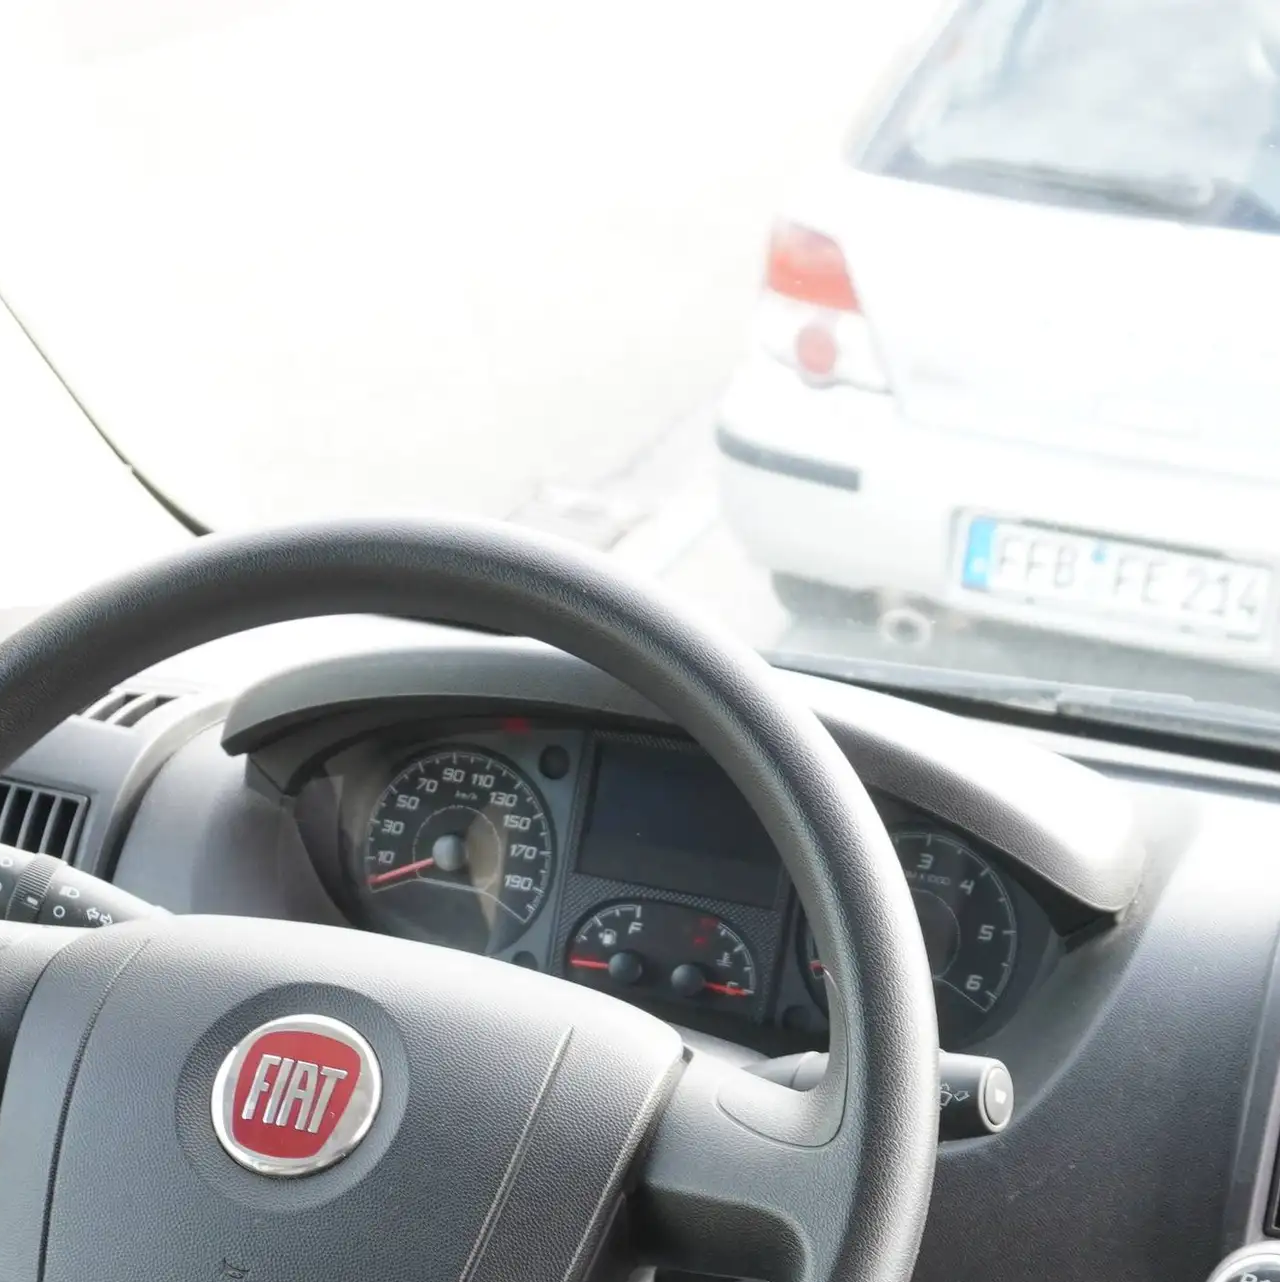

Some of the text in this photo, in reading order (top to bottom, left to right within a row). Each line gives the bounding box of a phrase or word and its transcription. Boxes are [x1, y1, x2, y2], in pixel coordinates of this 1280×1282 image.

[998, 532, 1260, 620] FFB FE 214
[442, 768, 465, 783] 90
[471, 773, 495, 788] 110
[416, 777, 439, 793] 70
[396, 794, 420, 811] 50
[489, 791, 517, 808] 130
[381, 819, 405, 835] 30
[503, 814, 531, 831] 150
[377, 850, 396, 864] 10
[510, 844, 537, 860] 170
[917, 853, 934, 870] 3
[504, 874, 533, 892] 190
[959, 879, 976, 895] 4
[628, 921, 644, 935] F
[977, 924, 995, 941] 5
[965, 974, 984, 991] 6
[241, 1053, 348, 1134] FIAT
